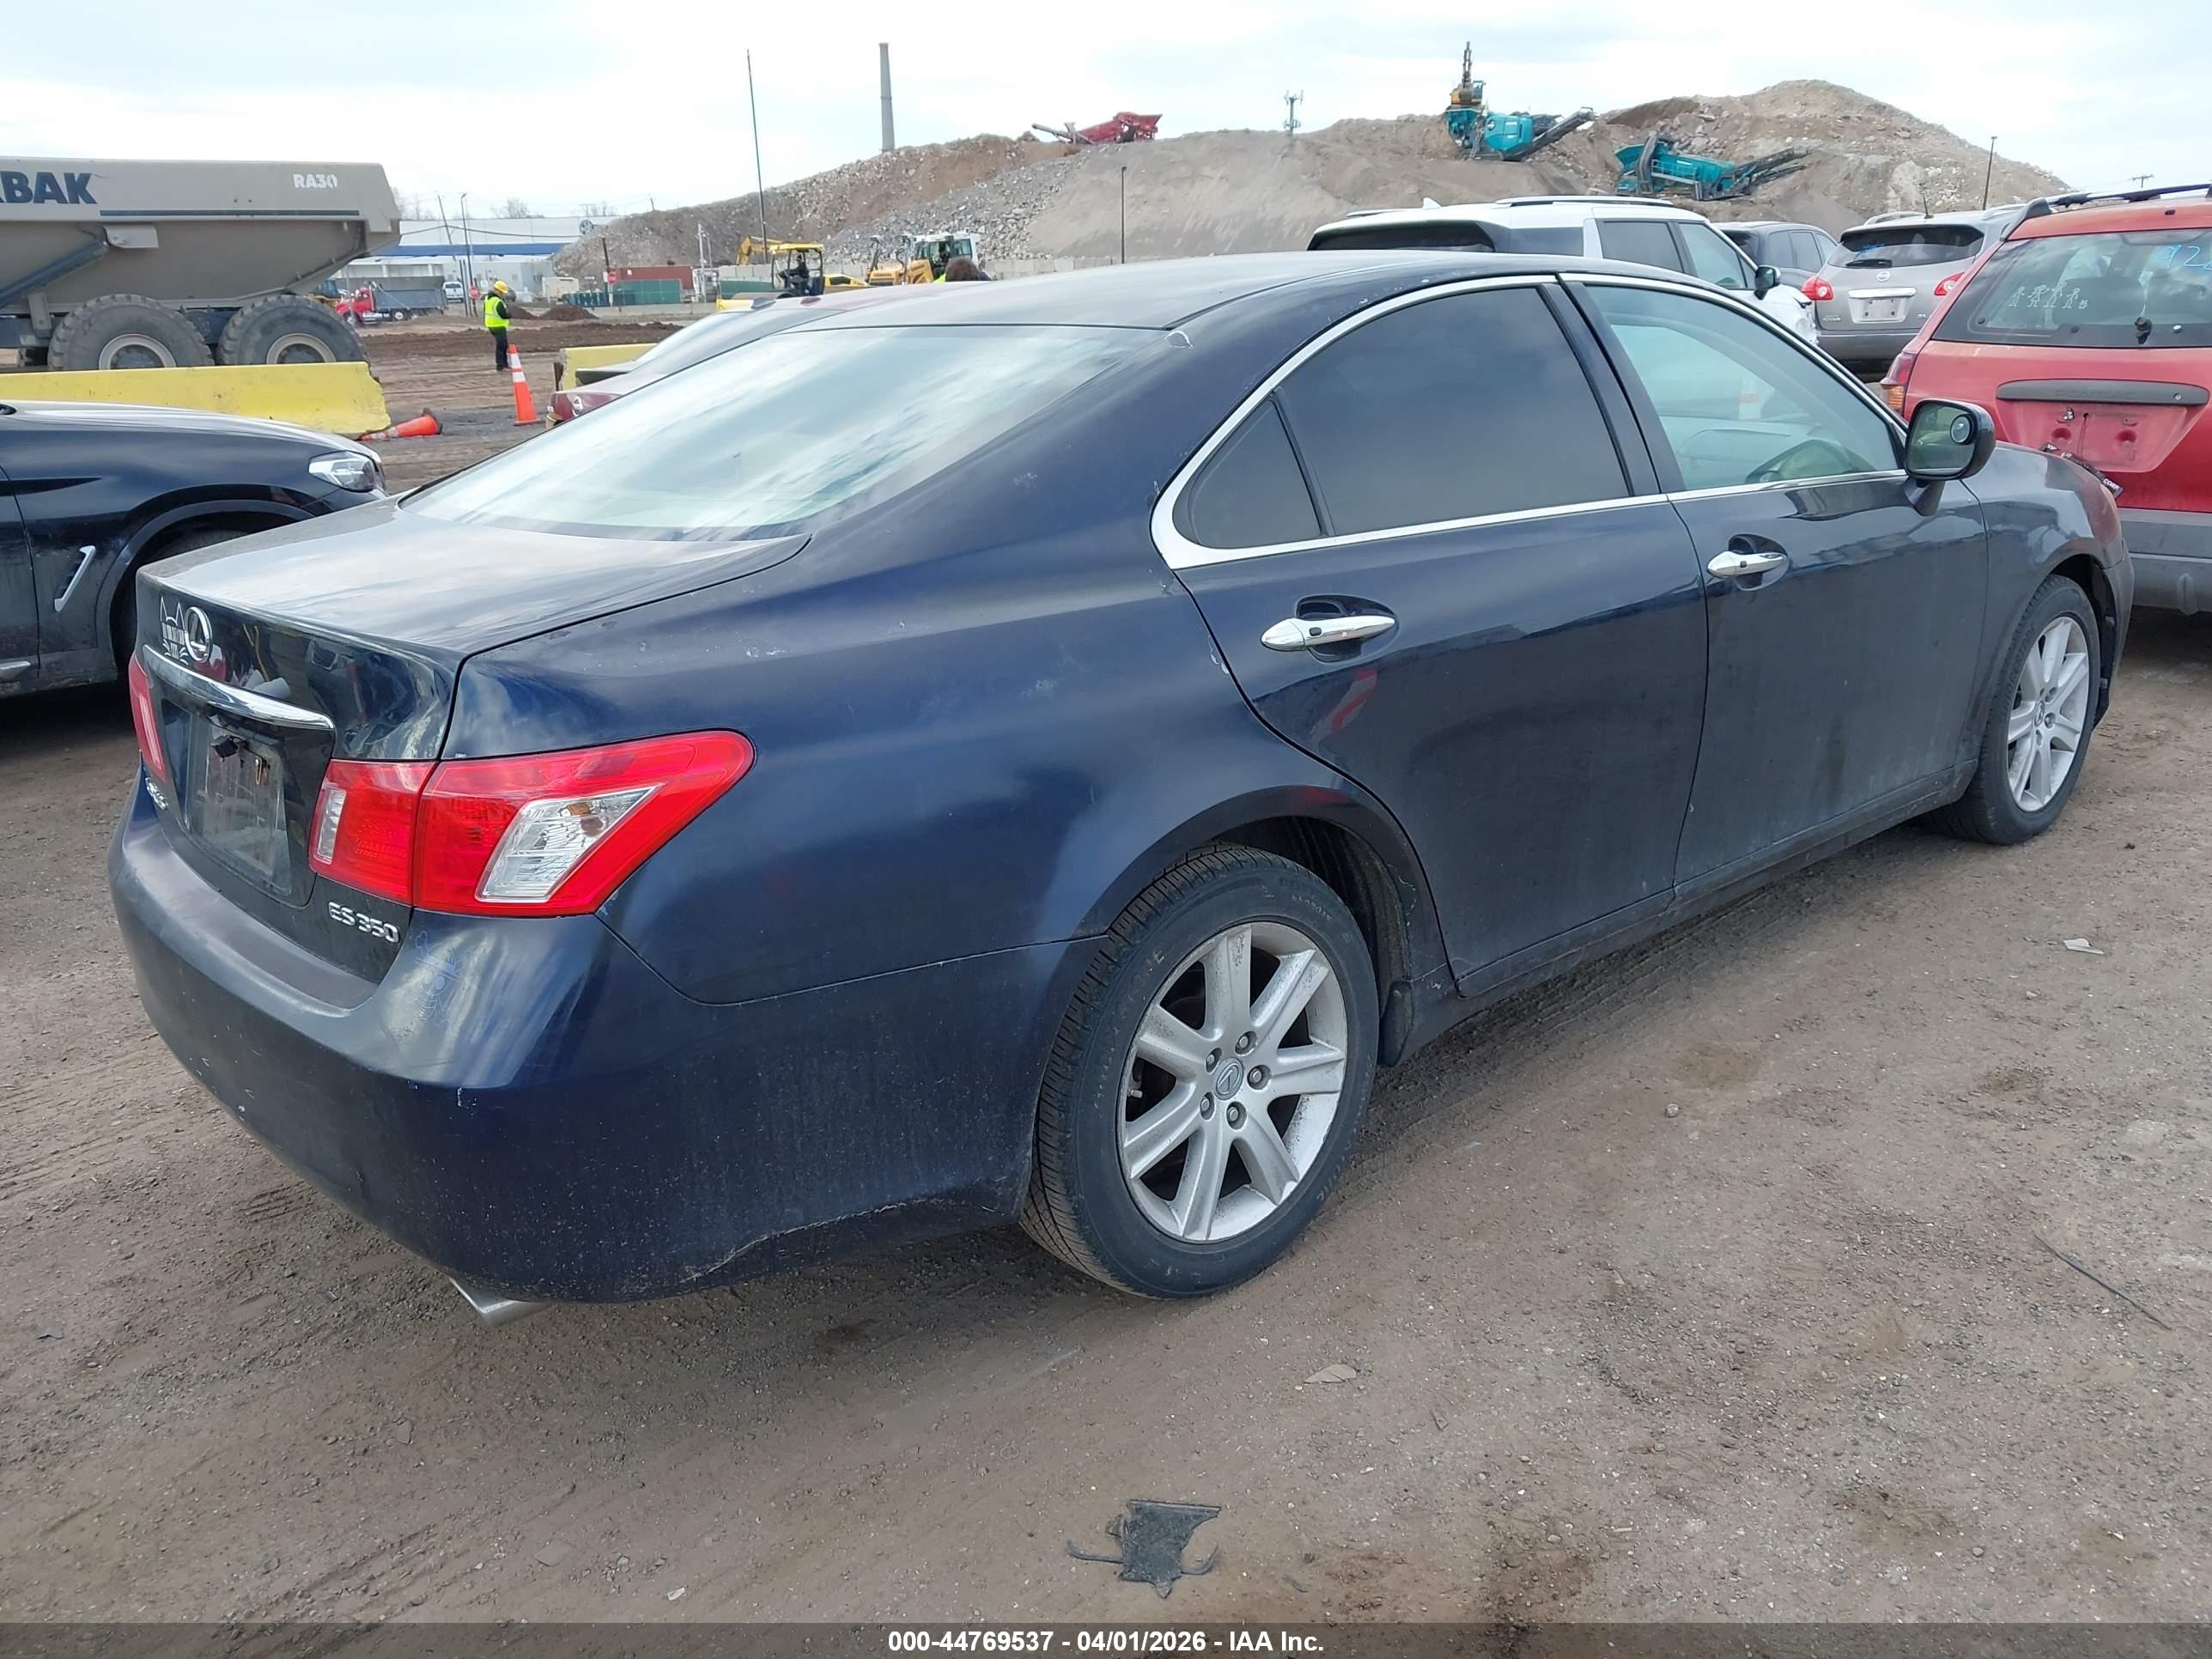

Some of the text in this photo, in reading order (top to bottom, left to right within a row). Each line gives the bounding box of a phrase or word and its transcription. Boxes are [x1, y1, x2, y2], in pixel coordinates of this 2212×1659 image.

[0, 171, 97, 204] BAK
[293, 173, 337, 188] RA30
[328, 901, 399, 943] ES 350
